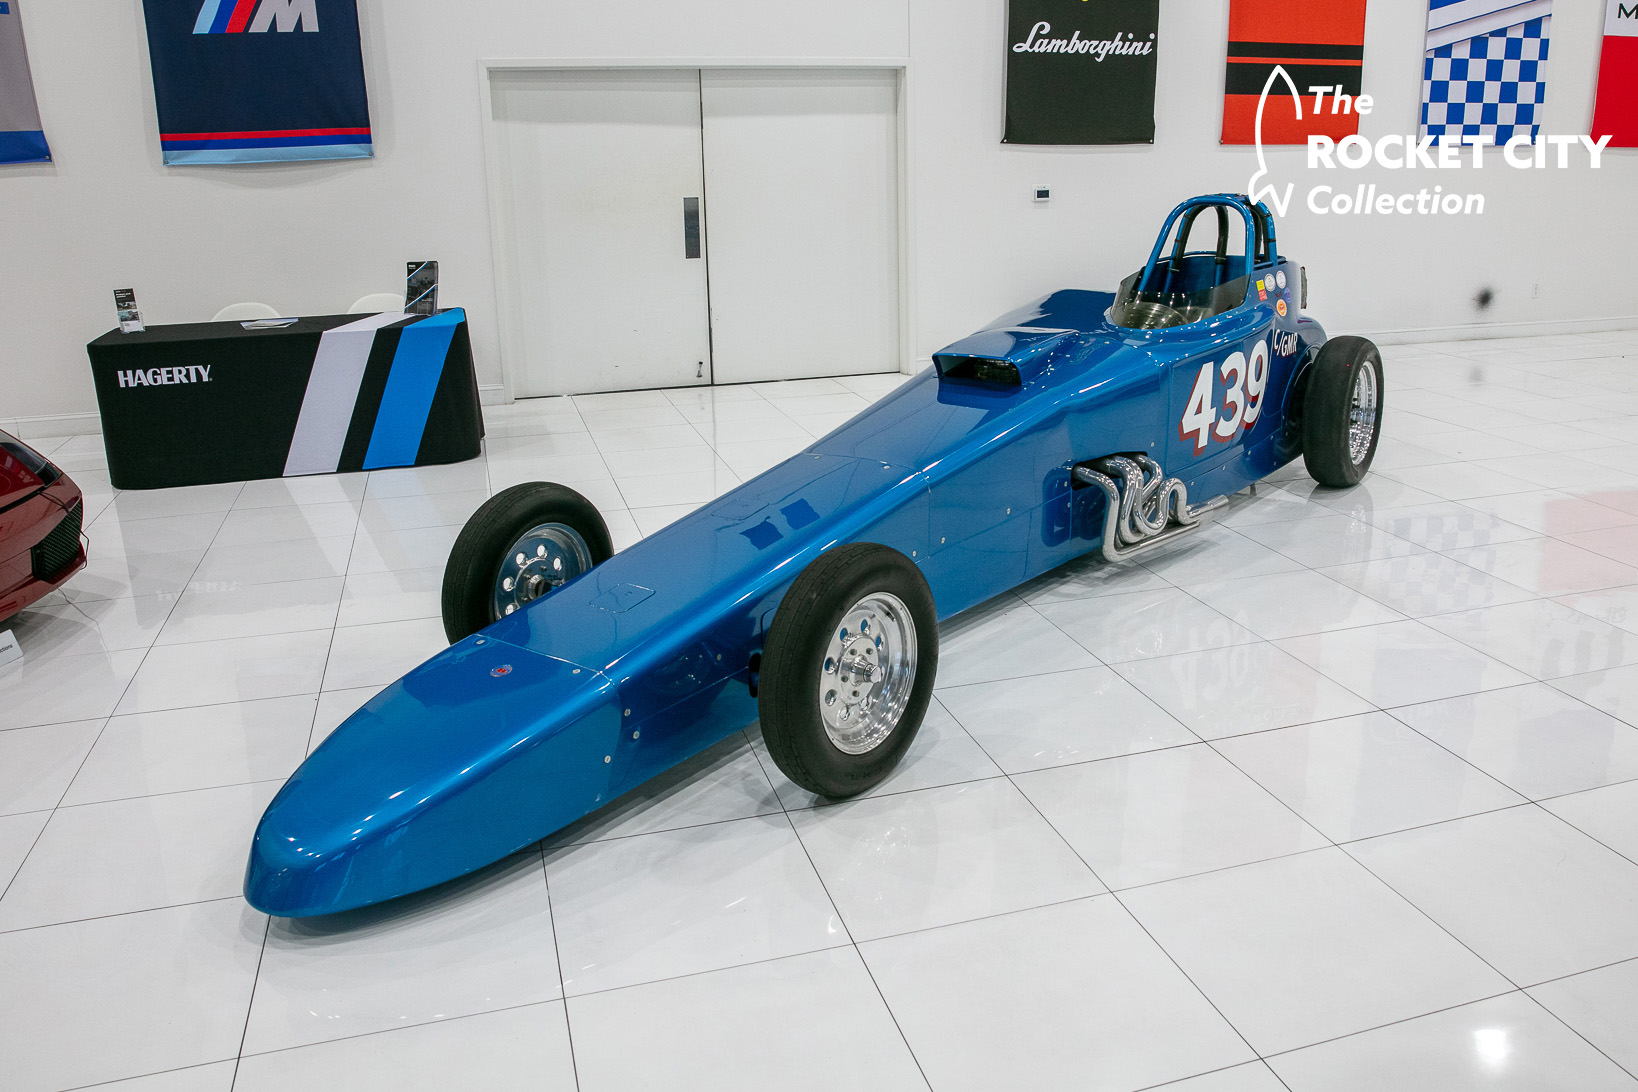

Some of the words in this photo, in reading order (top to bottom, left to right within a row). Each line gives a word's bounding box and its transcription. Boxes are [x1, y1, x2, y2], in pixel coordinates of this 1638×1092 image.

[248, 0, 319, 33] M
[1617, 2, 1638, 20] M
[1012, 21, 1156, 62] Lamborghini
[117, 364, 212, 388] HAGERTY
[1180, 339, 1269, 452] 439
